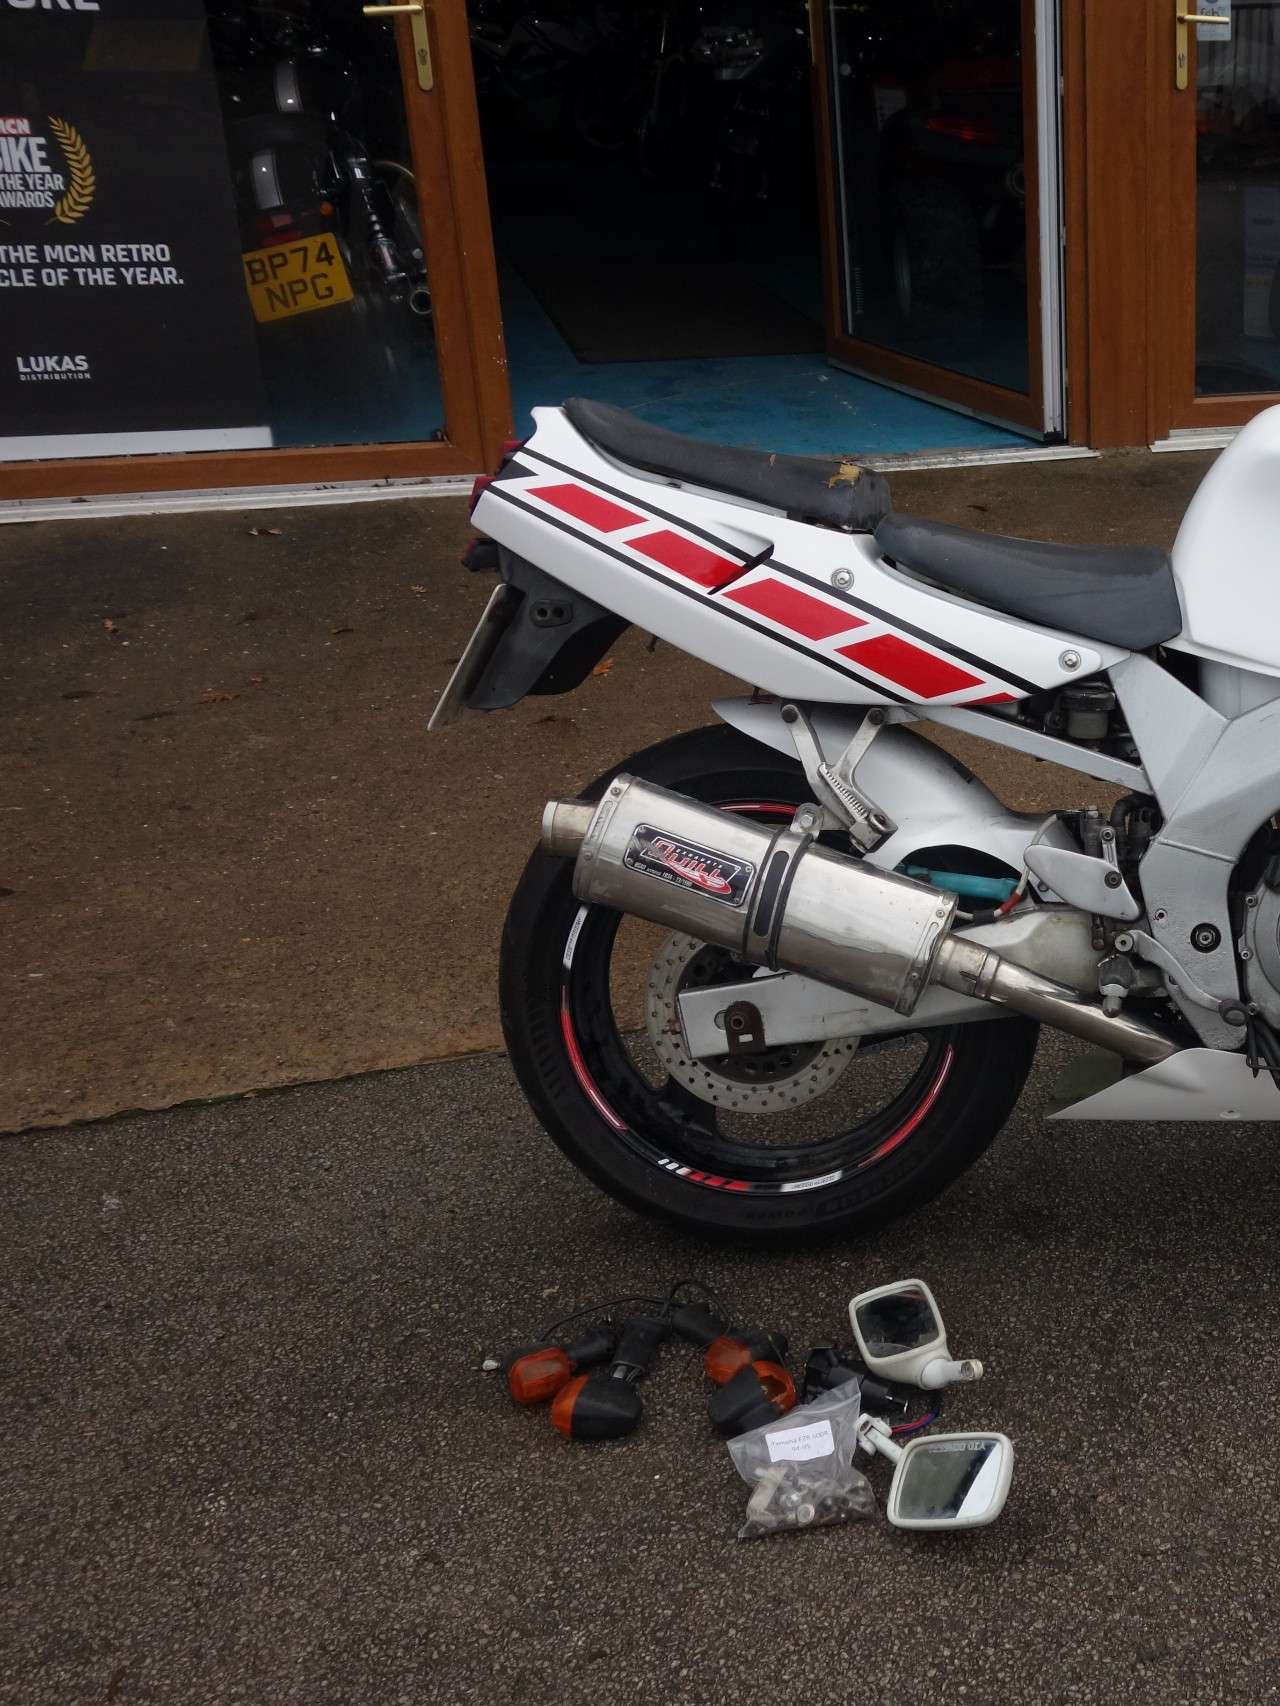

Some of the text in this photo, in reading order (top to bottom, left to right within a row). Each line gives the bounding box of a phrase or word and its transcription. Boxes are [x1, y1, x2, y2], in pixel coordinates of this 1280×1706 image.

[0, 136, 52, 173] IKE
[24, 173, 66, 191] YEAR
[0, 243, 171, 264] THE MCN RETRO
[245, 241, 335, 286] BP74
[41, 268, 70, 287] OF
[73, 266, 118, 287] THE
[120, 266, 185, 286] YEAR.
[263, 272, 334, 313] NPG
[16, 355, 89, 373] LUKAS
[20, 372, 91, 382] DISTRIBUTION
